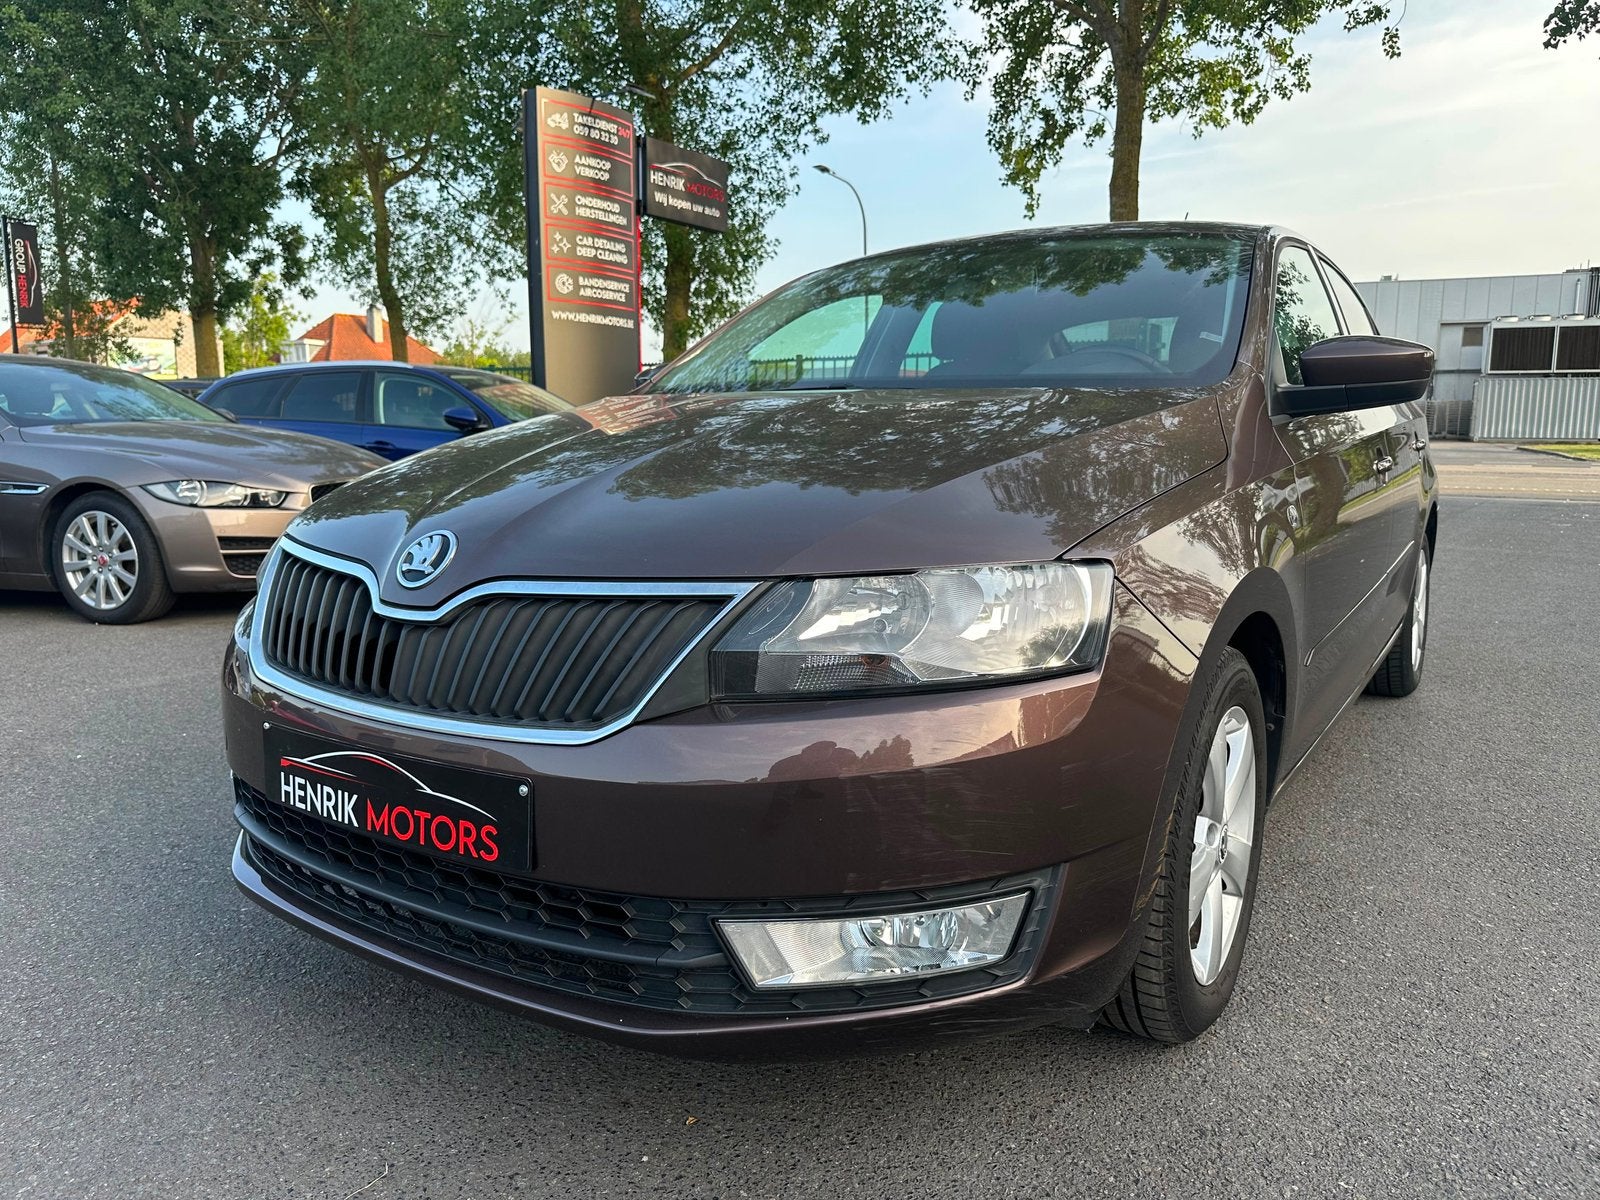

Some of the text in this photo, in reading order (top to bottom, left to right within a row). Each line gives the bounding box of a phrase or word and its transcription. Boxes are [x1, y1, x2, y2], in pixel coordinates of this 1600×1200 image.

[573, 112, 618, 135] TAKELDIENST
[573, 124, 589, 137] 059
[590, 128, 600, 140] 80
[600, 131, 610, 143] 32
[574, 153, 612, 171] AANKOOP
[574, 165, 610, 181] VERKOOP
[650, 170, 725, 203] HENRIK MOTORS
[575, 195, 621, 213] ONDERHOUD
[654, 191, 721, 218] Wij kopen uw auto
[575, 206, 628, 226] HERSTELLINGEN
[576, 235, 627, 253] CAR DETAILING
[576, 246, 628, 264] DEEP CLEANING
[14, 238, 29, 308] GROUP HENRIK
[578, 276, 630, 293] BANDENSERVICE
[579, 287, 626, 302] AIRCOSERVICE
[280, 771, 499, 862] HENRIK MOTORS
